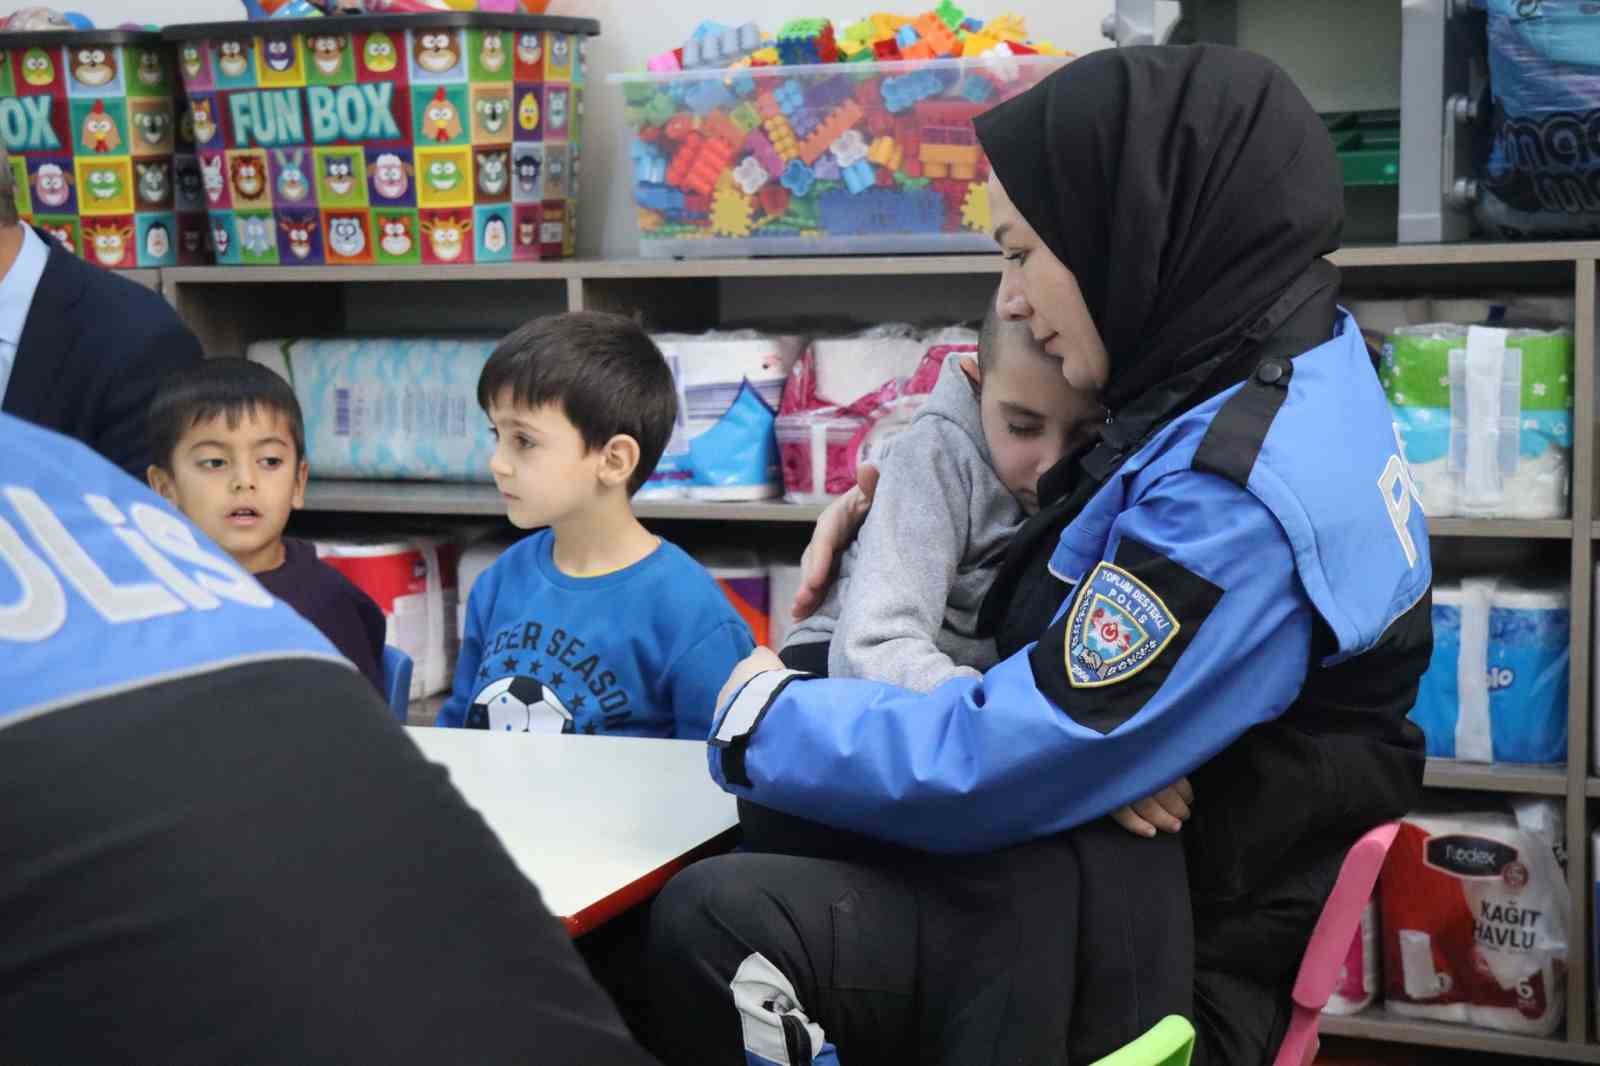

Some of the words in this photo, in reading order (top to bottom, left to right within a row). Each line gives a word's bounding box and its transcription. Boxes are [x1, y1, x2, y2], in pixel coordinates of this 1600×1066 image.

[229, 88, 306, 147] FUN
[306, 80, 402, 144] BOX
[1102, 570, 1133, 593] TOPLUM
[486, 621, 542, 658] CER
[1481, 899, 1542, 927] KAĞIT
[1472, 918, 1535, 949] HAVLU
[1516, 977, 1534, 1000] 6
